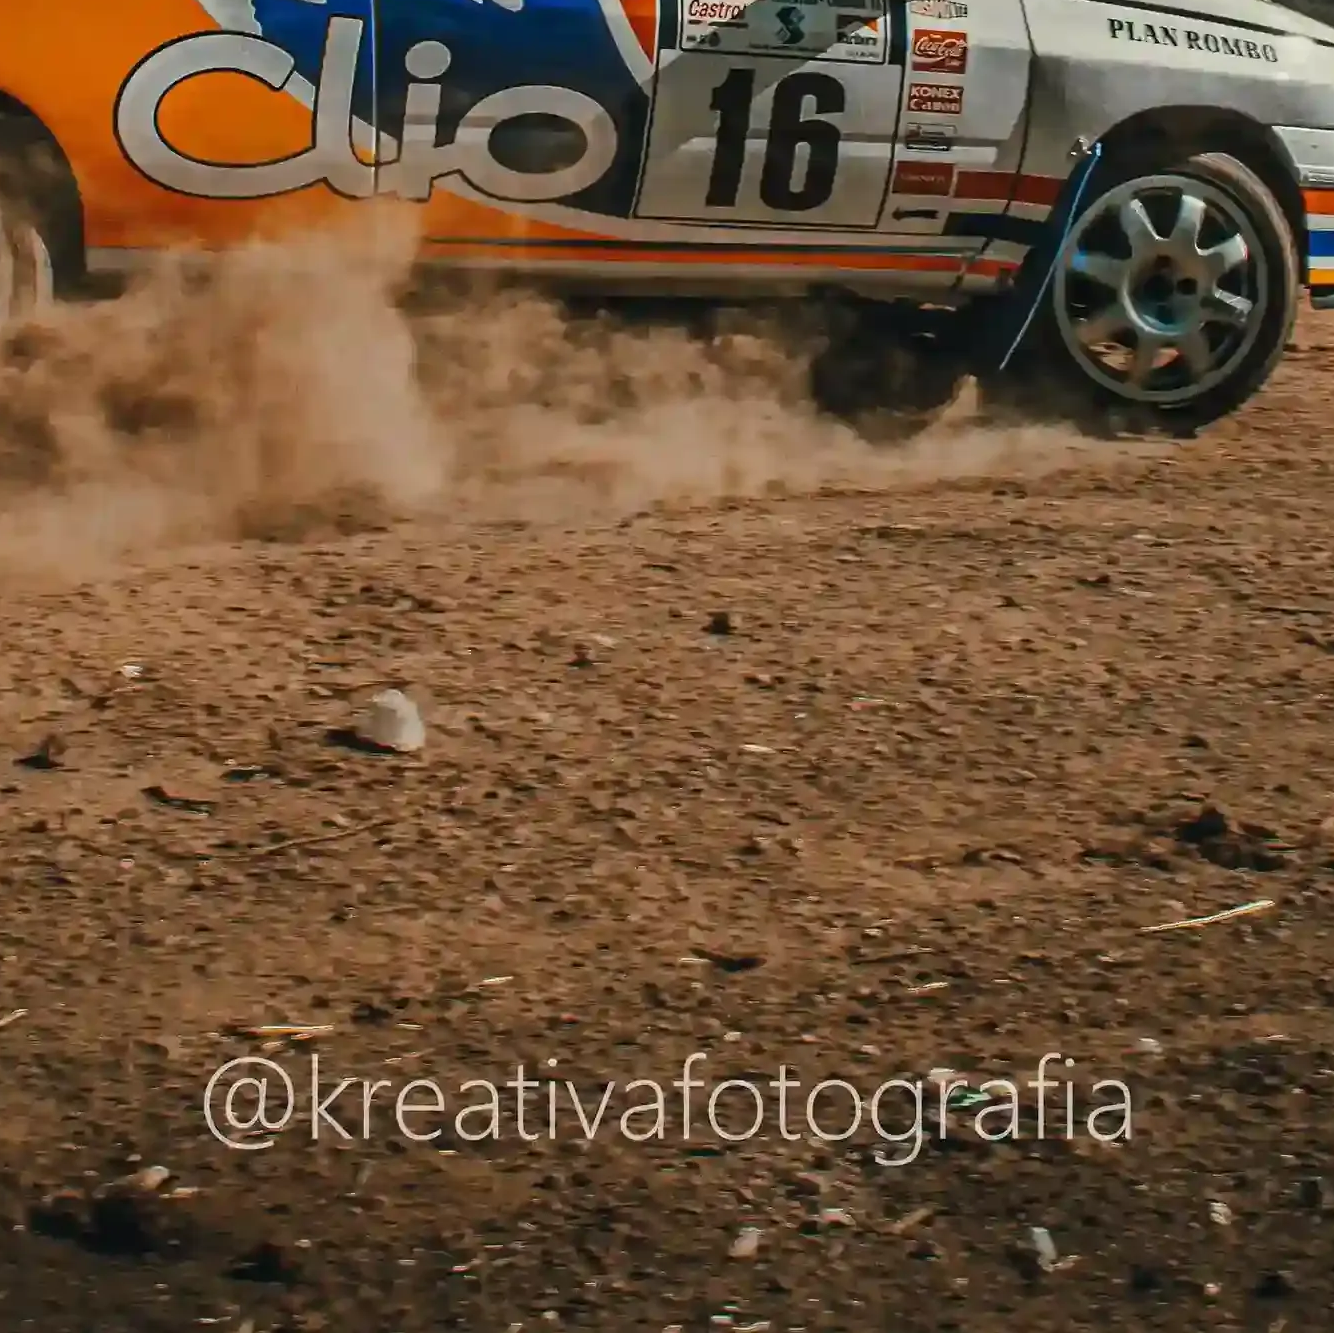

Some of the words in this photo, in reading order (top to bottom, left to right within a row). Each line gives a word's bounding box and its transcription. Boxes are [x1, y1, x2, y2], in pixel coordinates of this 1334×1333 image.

[1107, 17, 1179, 48] PLAN
[1184, 29, 1279, 64] ROMBO
[909, 98, 960, 112] Canon
[910, 86, 961, 100] KONEX
[705, 67, 846, 212] 16
